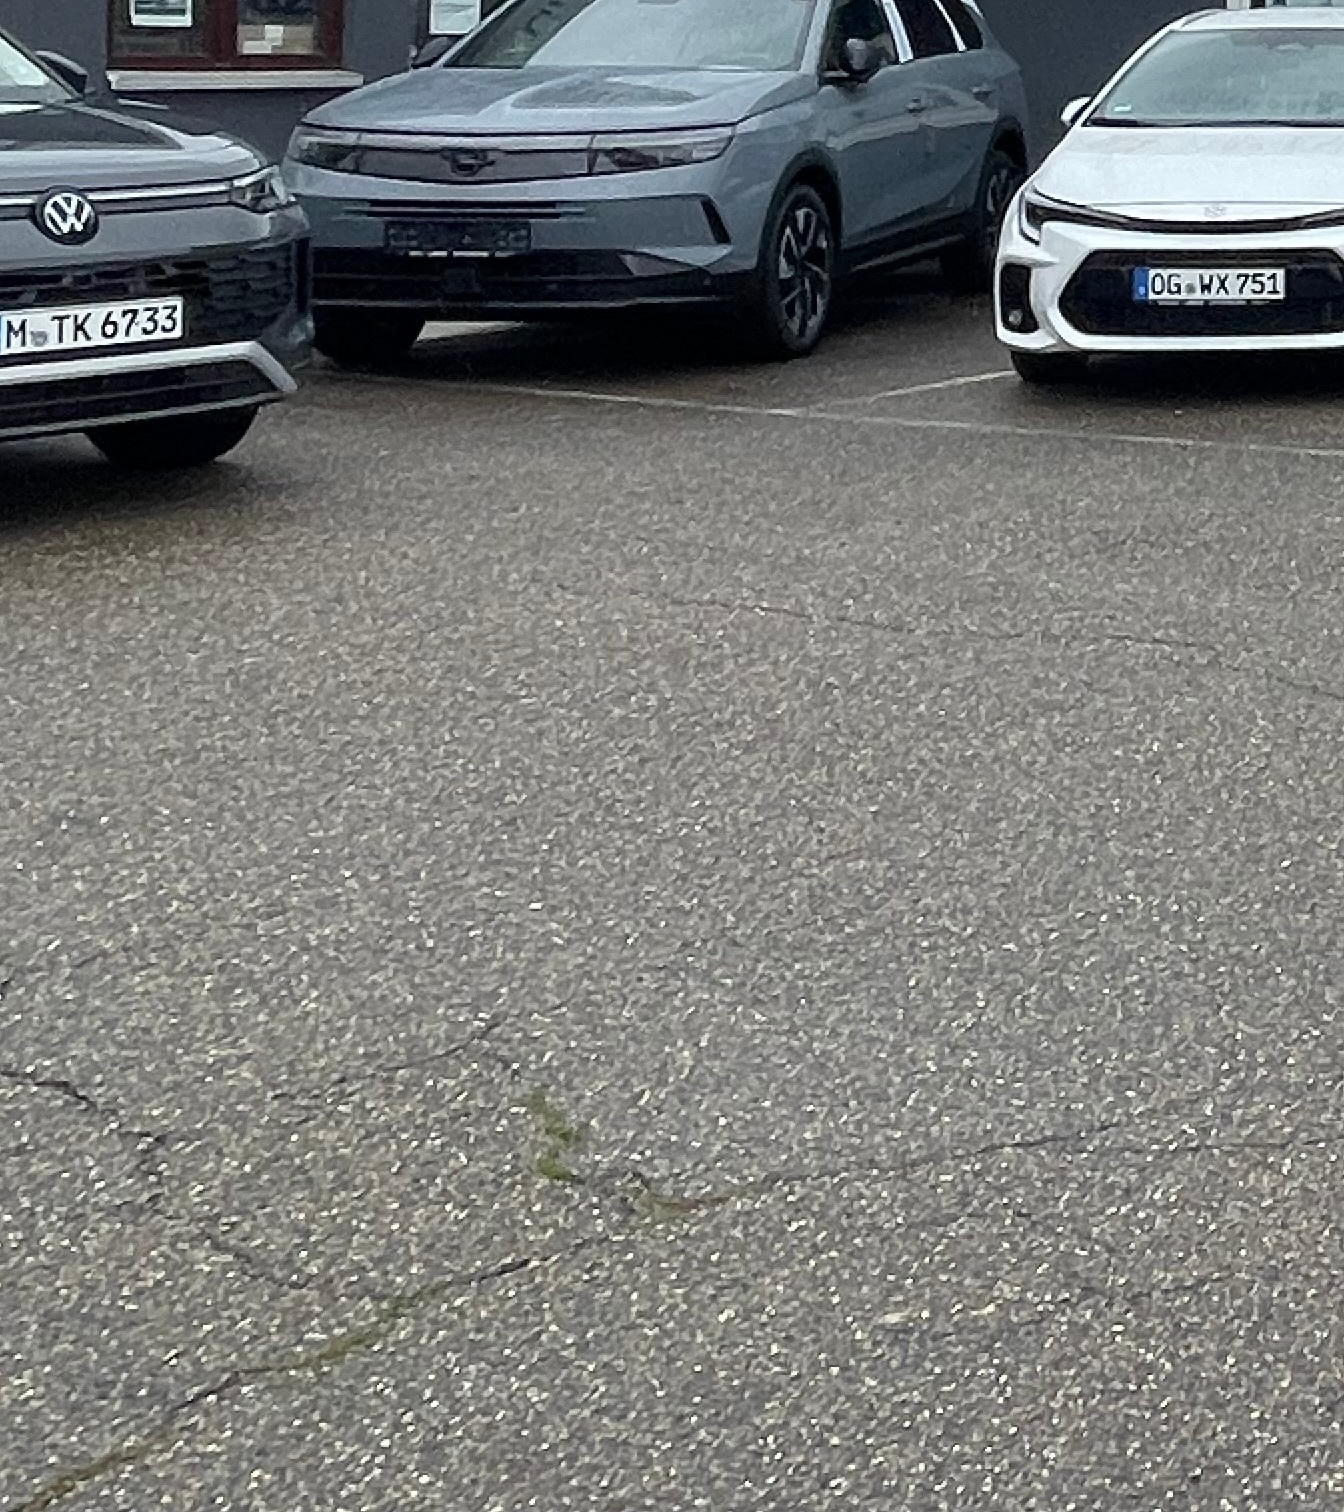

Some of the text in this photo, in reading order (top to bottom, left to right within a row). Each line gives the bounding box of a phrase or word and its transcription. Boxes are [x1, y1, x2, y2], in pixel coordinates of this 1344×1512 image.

[1150, 272, 1281, 296] OG WX 751
[6, 304, 178, 349] M TK 6733
